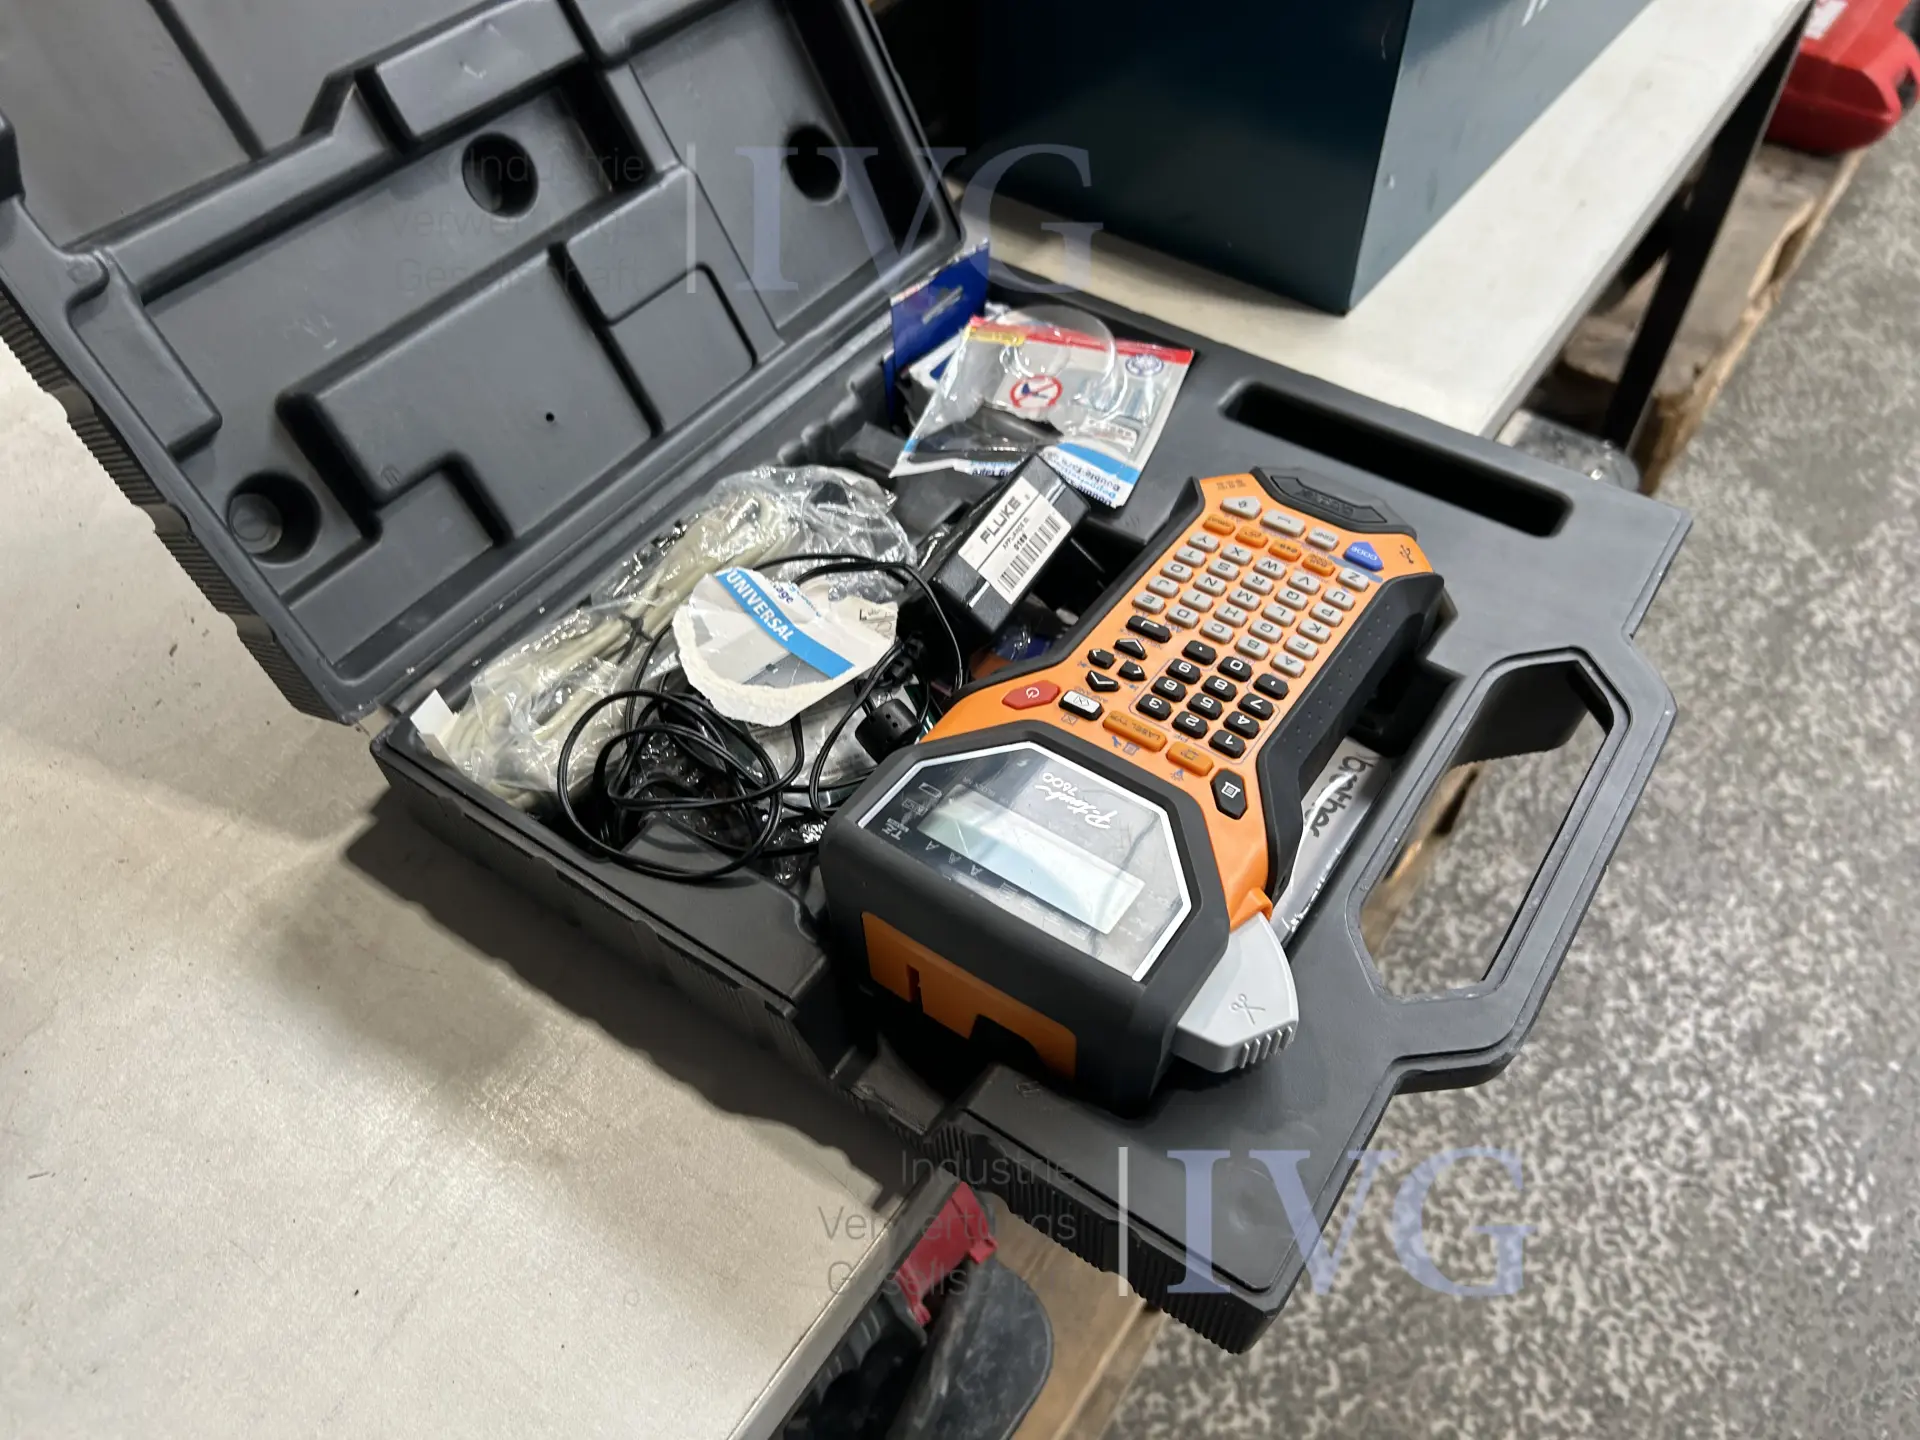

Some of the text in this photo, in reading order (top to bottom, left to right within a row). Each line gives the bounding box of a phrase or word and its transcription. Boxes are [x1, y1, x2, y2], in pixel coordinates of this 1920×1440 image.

[980, 496, 1021, 544] FLUKE
[1198, 537, 1207, 545] Y
[1232, 548, 1241, 556] X
[1218, 562, 1230, 570] S
[1263, 561, 1277, 570] W
[1252, 576, 1264, 585] R
[1297, 577, 1309, 585] V
[1348, 572, 1360, 581] Z
[1171, 564, 1321, 633] K L M N O
[1286, 592, 1299, 600] Q
[1333, 592, 1345, 601] U
[726, 569, 794, 641] UNIVERSAL
[1225, 607, 1238, 617] H
[1144, 596, 1296, 665] A B C D E
[1260, 623, 1273, 632] G
[1230, 661, 1243, 670] 0
[1179, 662, 1263, 708] 7 8 9
[1164, 680, 1250, 724] 4 5 6
[1149, 698, 1233, 744] 1 2 3
[1042, 772, 1077, 796] 7600
[1304, 756, 1374, 838] brother
